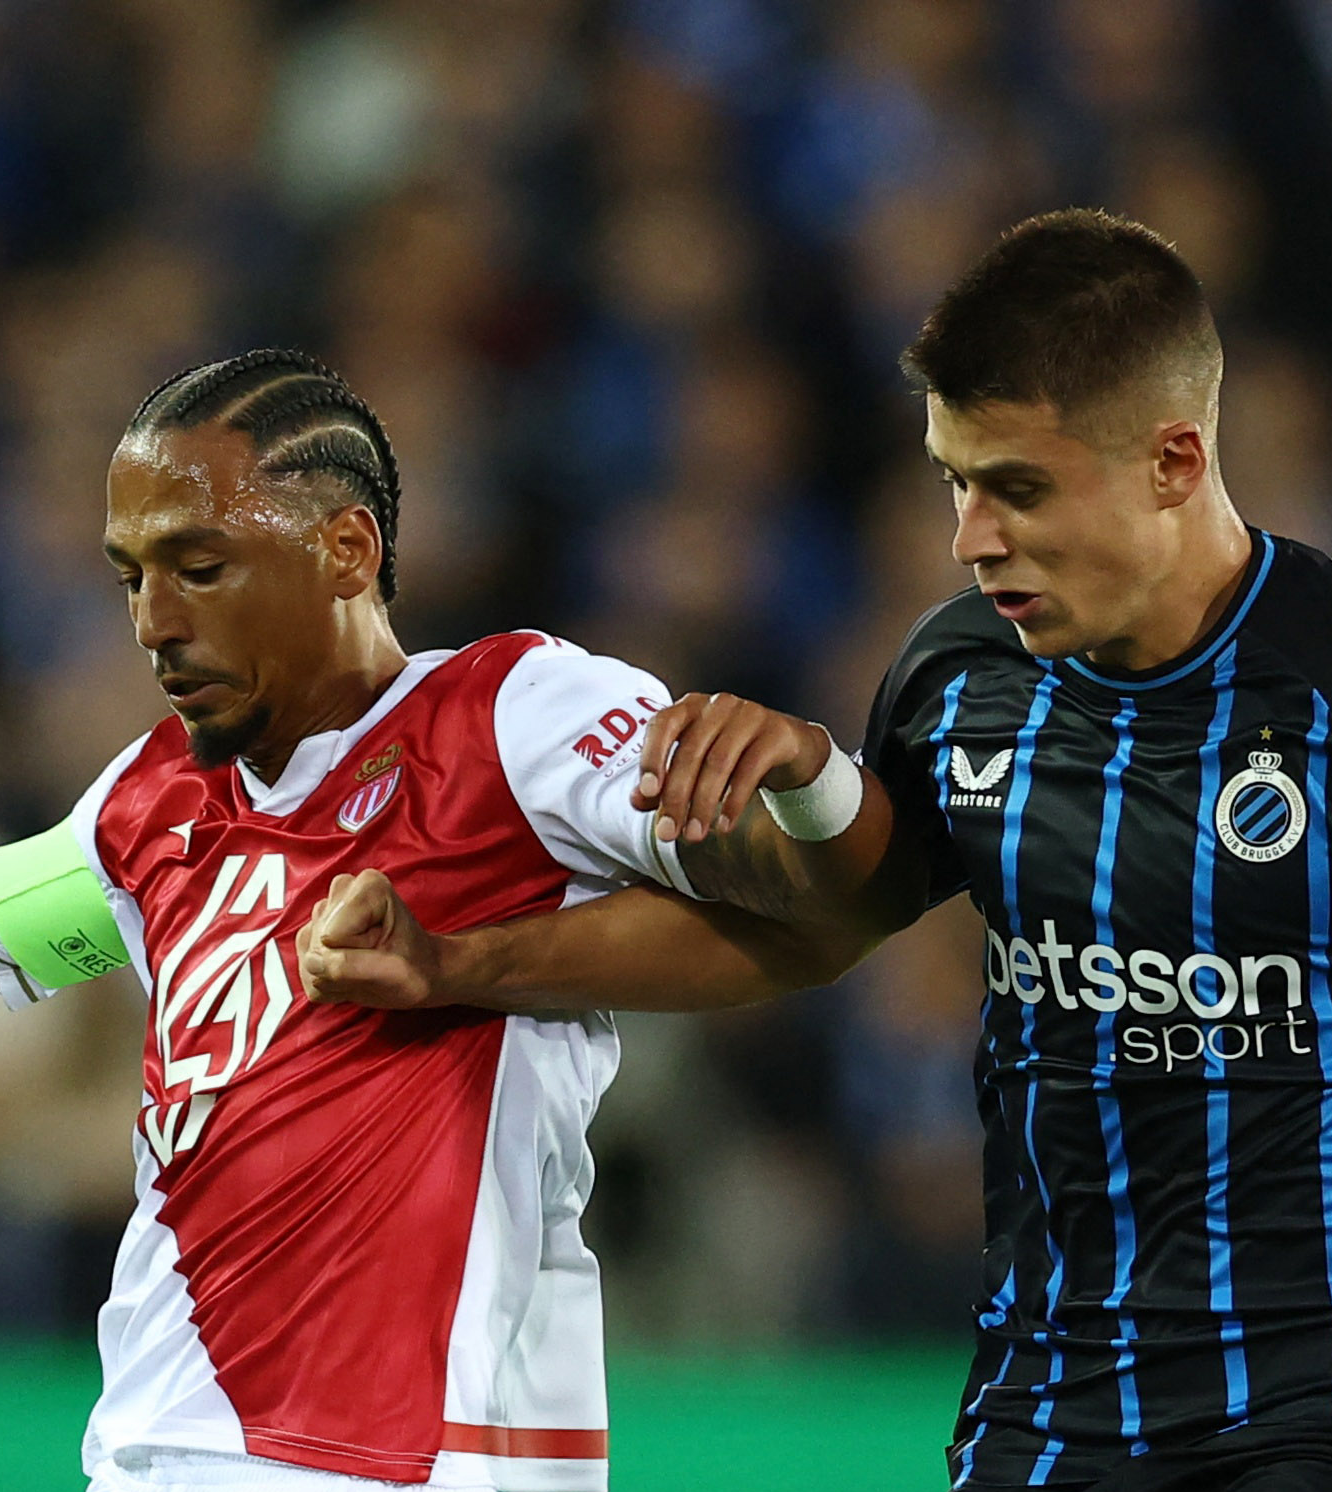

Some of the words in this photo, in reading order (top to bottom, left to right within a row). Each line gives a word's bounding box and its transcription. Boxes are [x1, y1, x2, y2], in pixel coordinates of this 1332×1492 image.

[1219, 822, 1240, 850] CLUB
[1241, 843, 1286, 860] BRUGGE
[1285, 827, 1300, 845] KV
[984, 914, 1303, 1019] betsson
